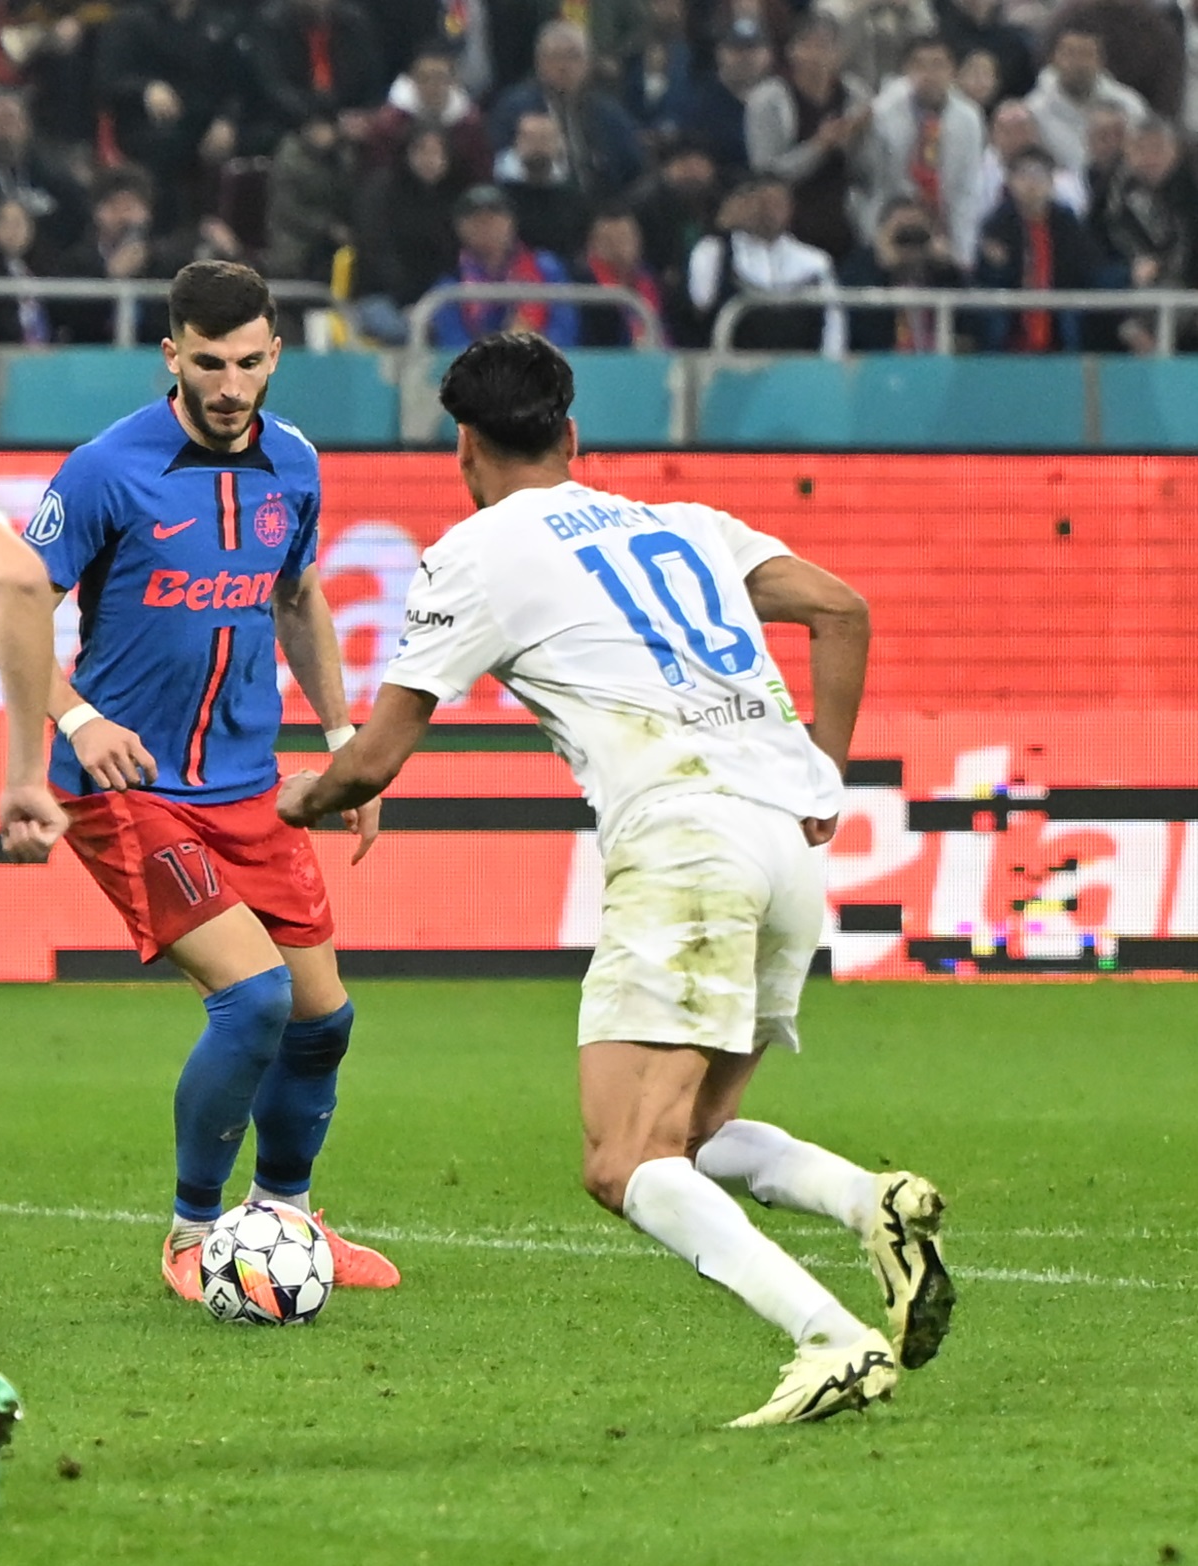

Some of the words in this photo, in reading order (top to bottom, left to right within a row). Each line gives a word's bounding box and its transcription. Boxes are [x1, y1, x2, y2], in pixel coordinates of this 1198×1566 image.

[143, 569, 281, 611] Betan
[574, 531, 764, 692] 10
[153, 842, 220, 906] 17
